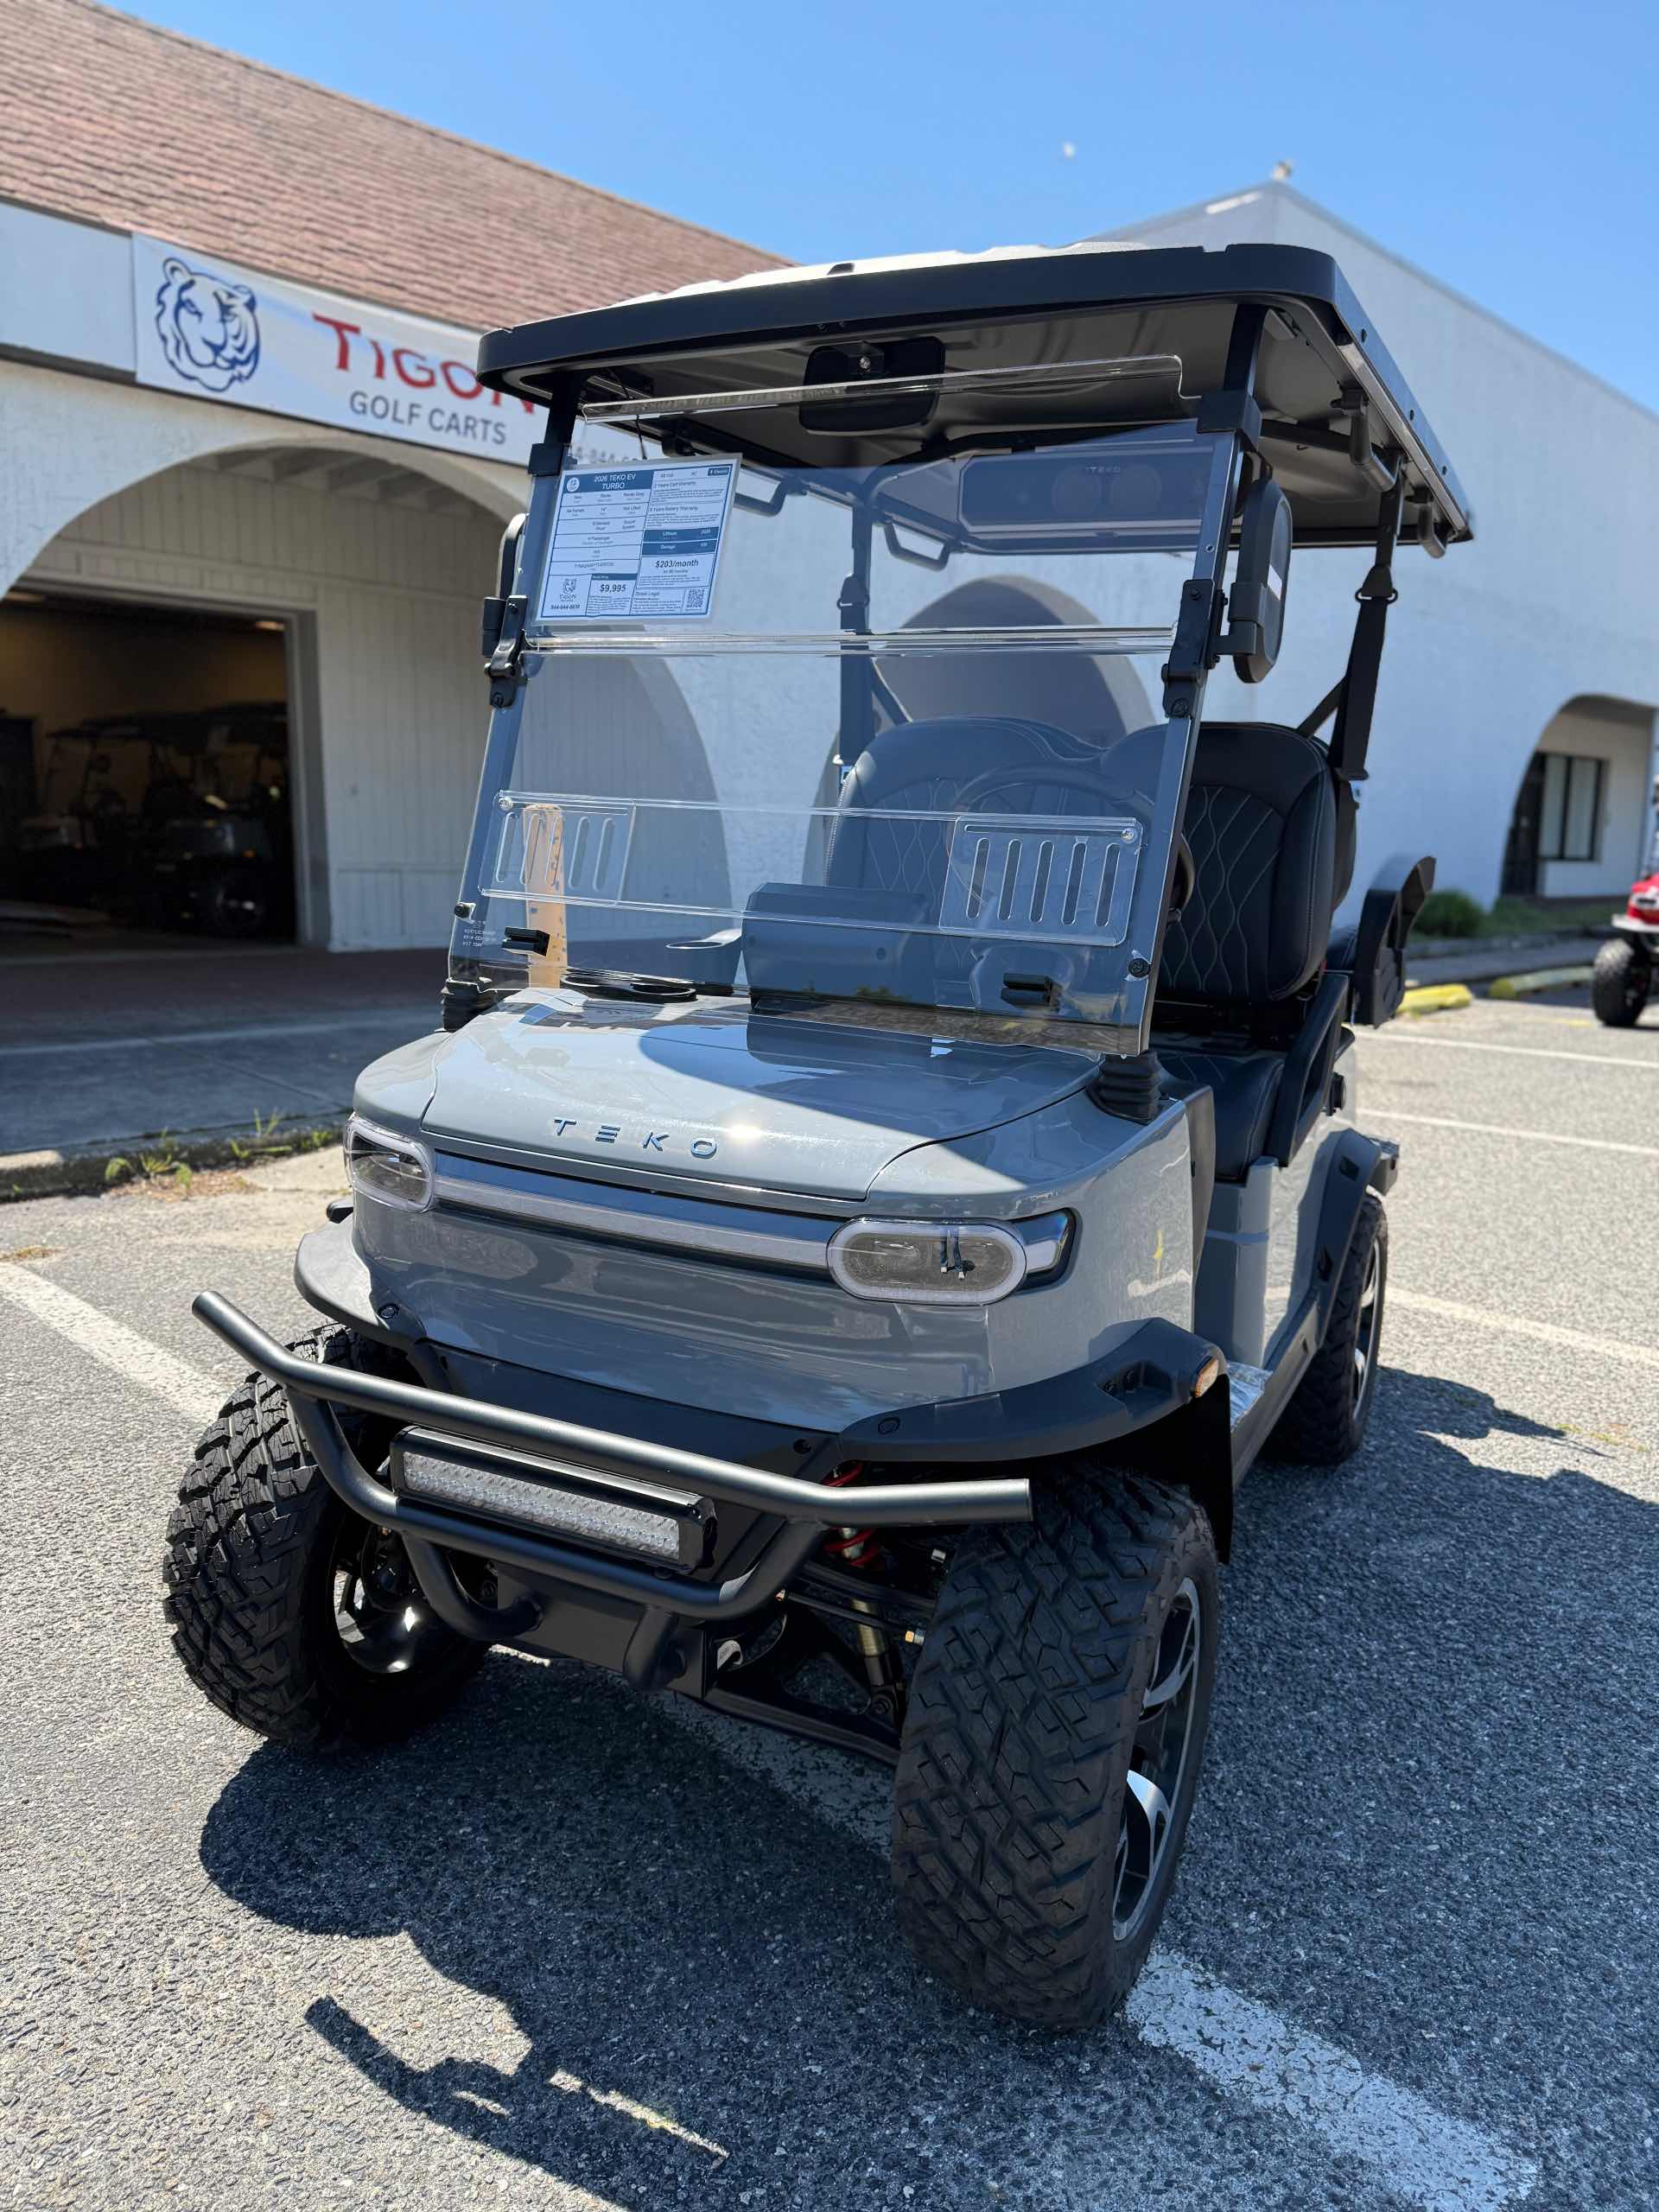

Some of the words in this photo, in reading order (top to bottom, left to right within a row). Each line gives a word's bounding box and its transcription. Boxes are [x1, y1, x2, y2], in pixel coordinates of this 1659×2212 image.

[349, 391, 423, 425] GOLF
[428, 407, 507, 445] CARTS
[655, 559, 699, 569] $203/month
[600, 584, 626, 593] $9,995
[553, 1116, 718, 1160] TEKO
